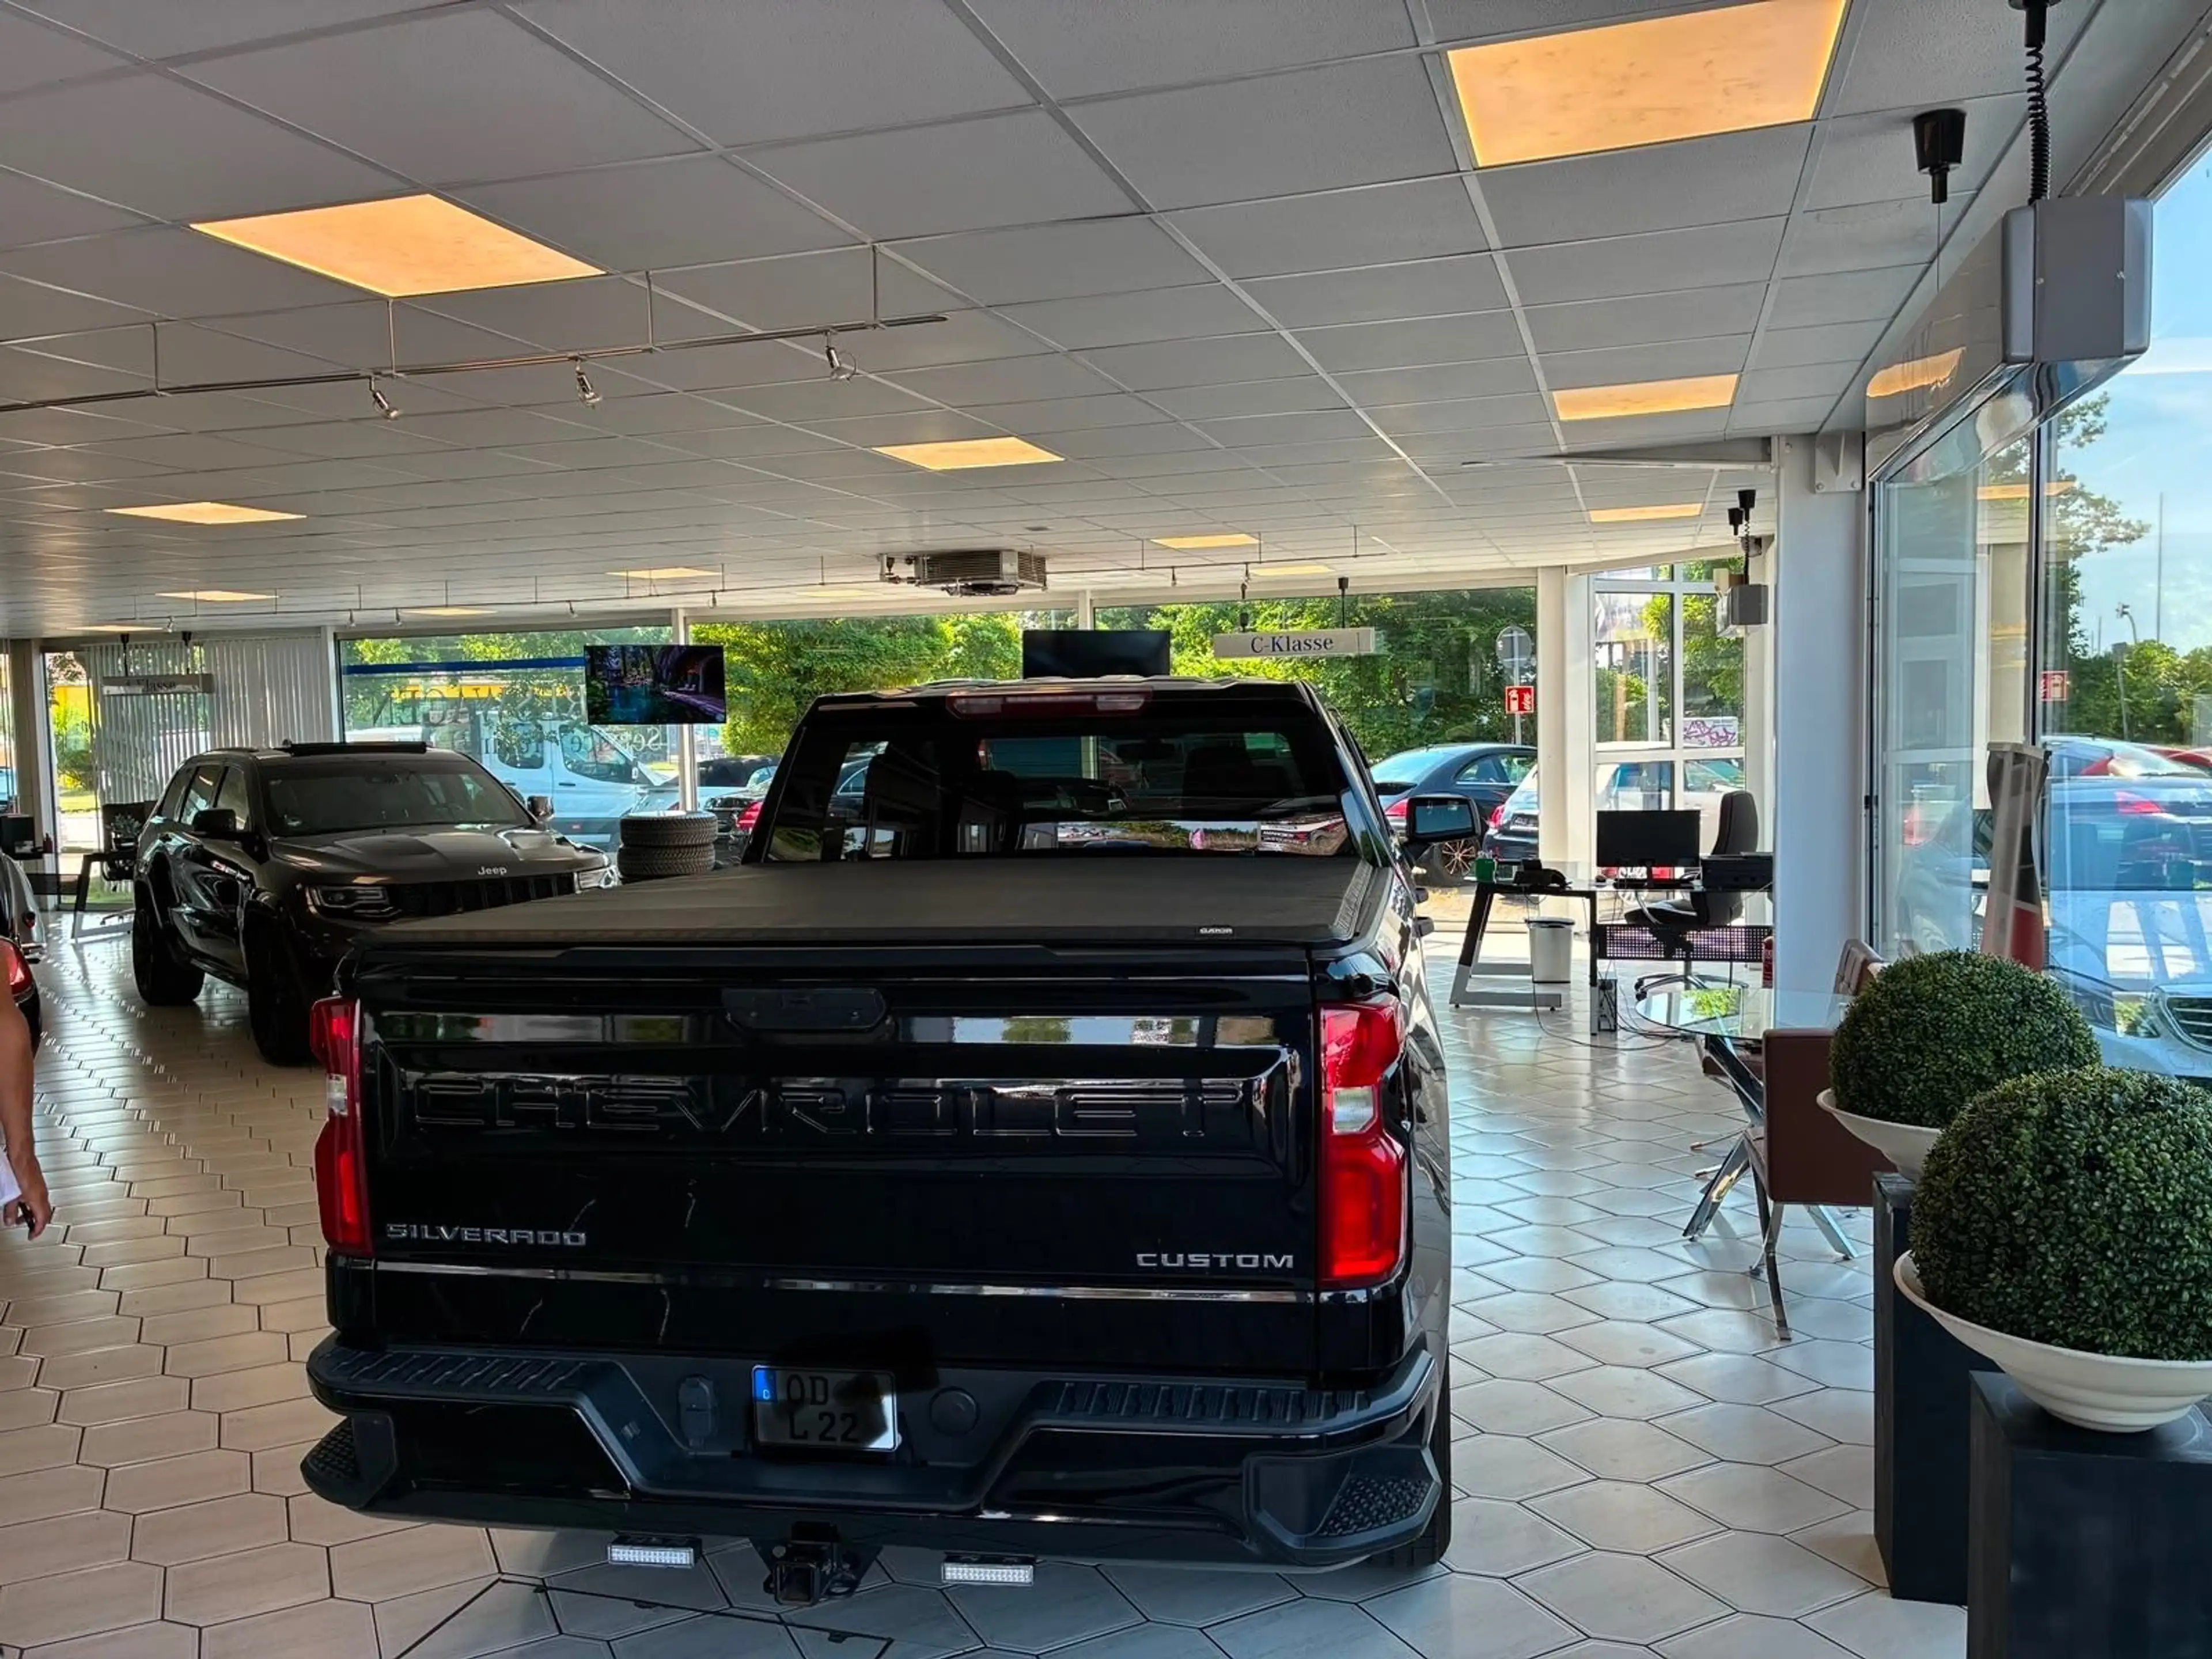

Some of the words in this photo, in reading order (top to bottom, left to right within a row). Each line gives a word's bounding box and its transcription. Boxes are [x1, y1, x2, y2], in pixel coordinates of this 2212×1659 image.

[1251, 636, 1334, 653] C-Klasse
[478, 866, 507, 876] Jeep
[415, 1076, 1243, 1137] CHEVROLET
[387, 1224, 586, 1245] SILVERADO
[1136, 1253, 1294, 1268] CUSTOM
[787, 1374, 828, 1405] OD
[788, 1411, 808, 1440] L
[818, 1412, 858, 1442] 22
